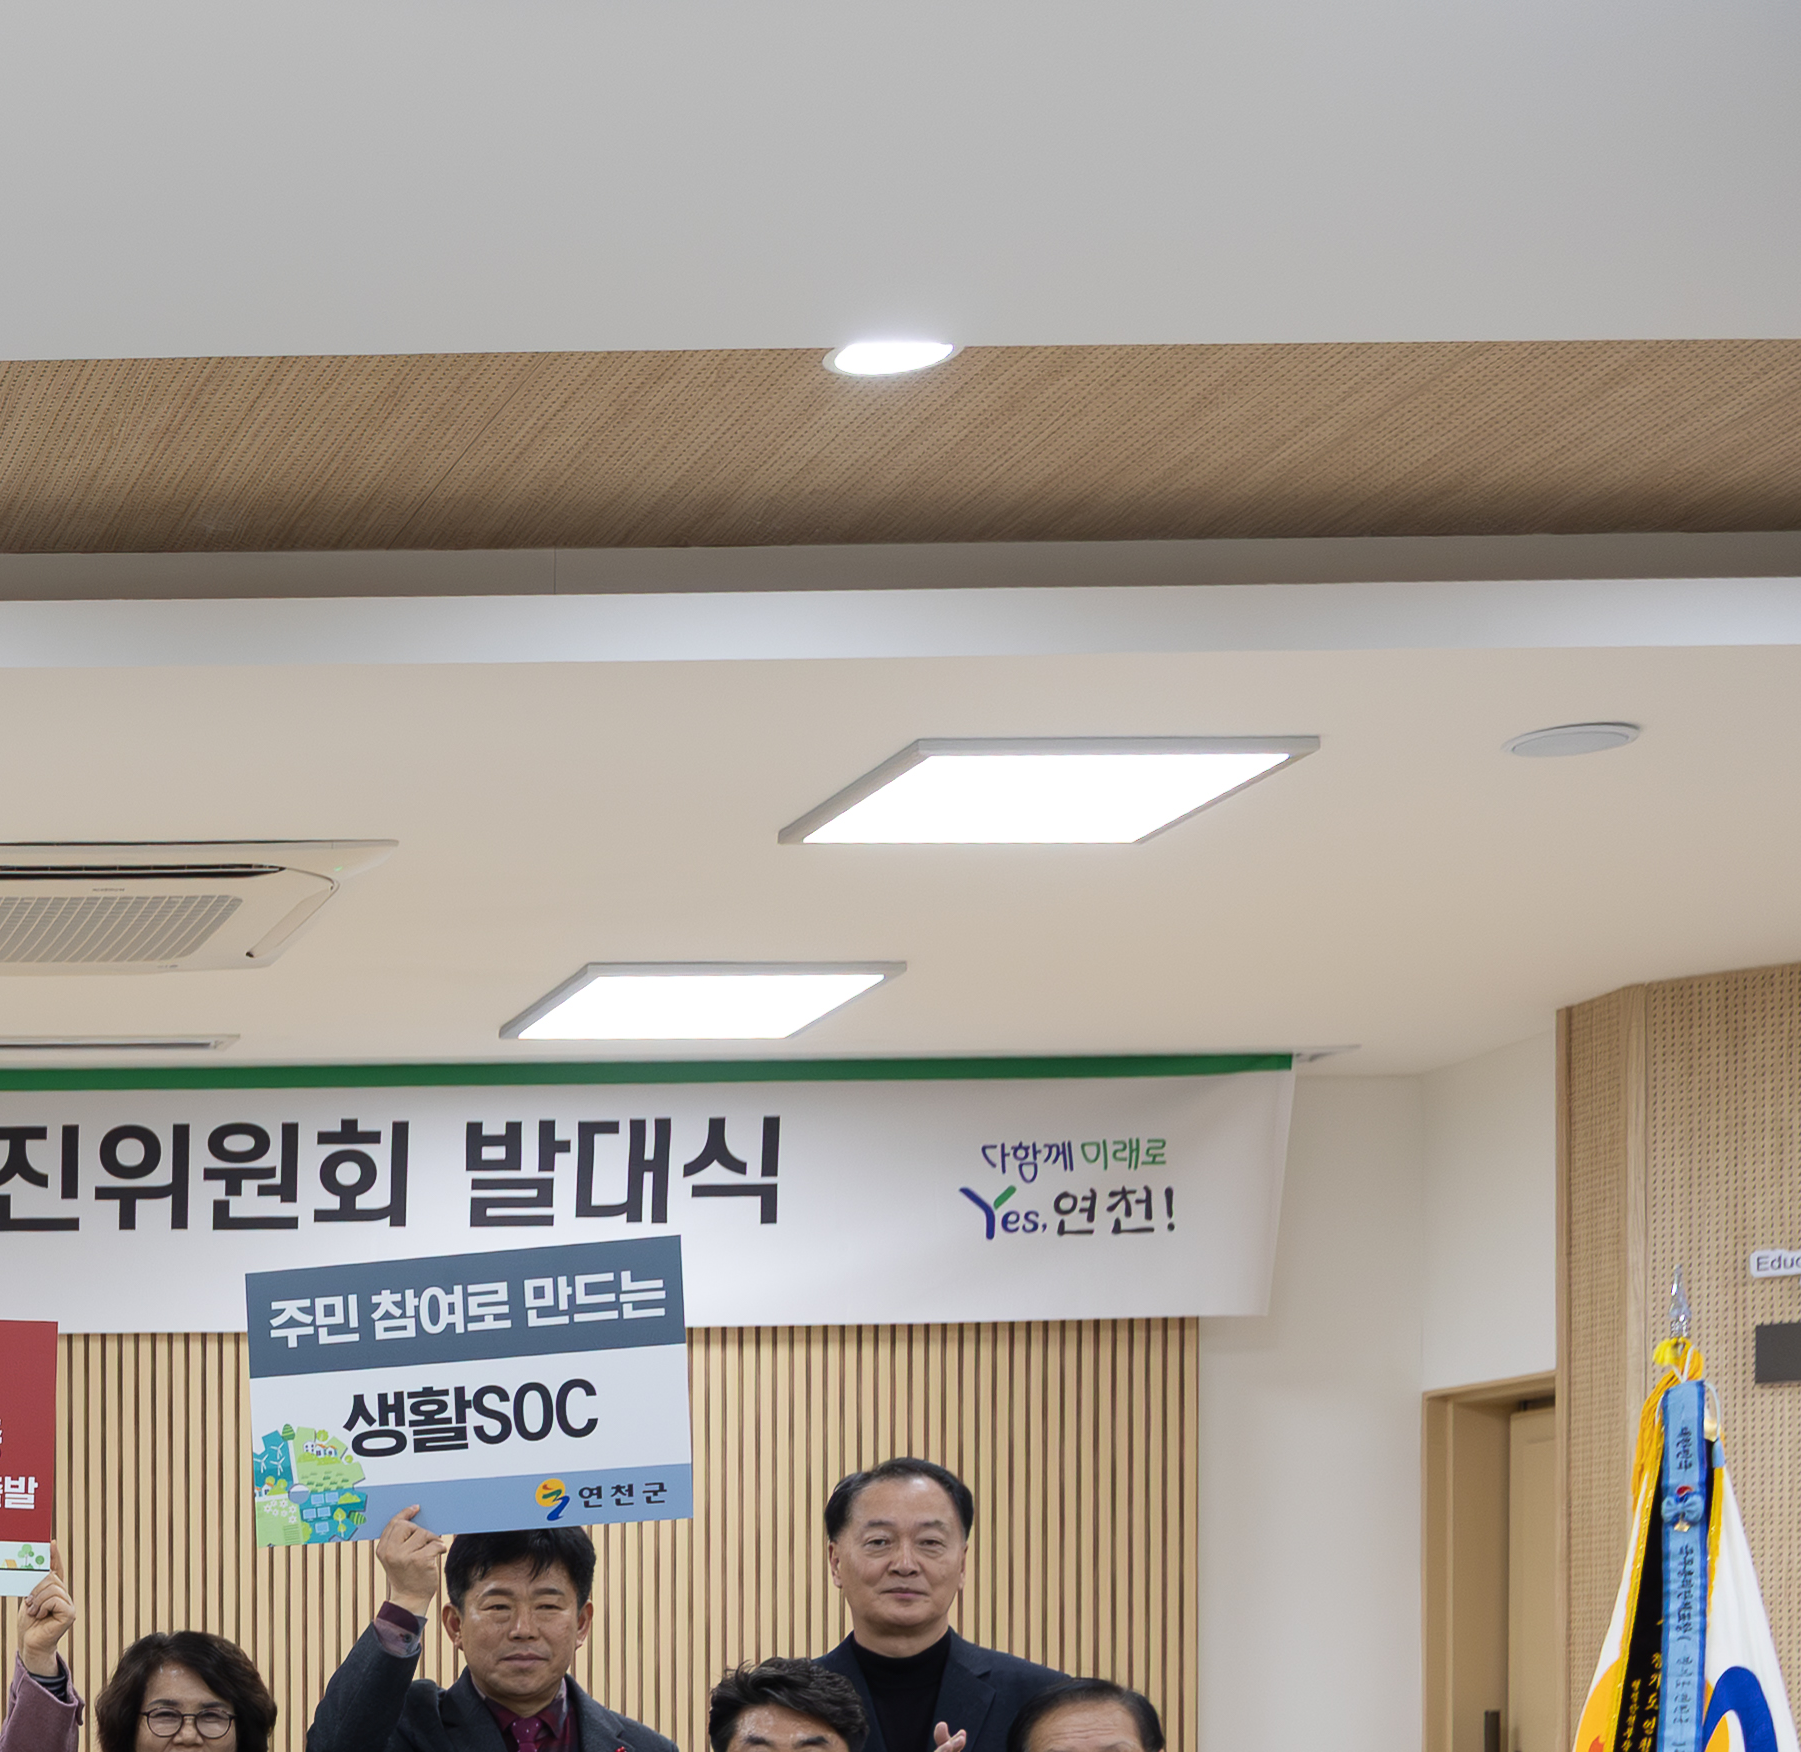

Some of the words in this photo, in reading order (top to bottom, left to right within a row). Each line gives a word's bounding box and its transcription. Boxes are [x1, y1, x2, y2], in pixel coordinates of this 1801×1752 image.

[463, 1114, 782, 1230] 발대식
[980, 1139, 1074, 1183] 다함께
[1082, 1137, 1168, 1171] 미래로
[269, 1293, 360, 1348] 주민
[371, 1281, 512, 1341] 참여로
[524, 1270, 666, 1328] 만드는
[343, 1378, 599, 1458] 생활SOC
[578, 1481, 667, 1509] 연천군
